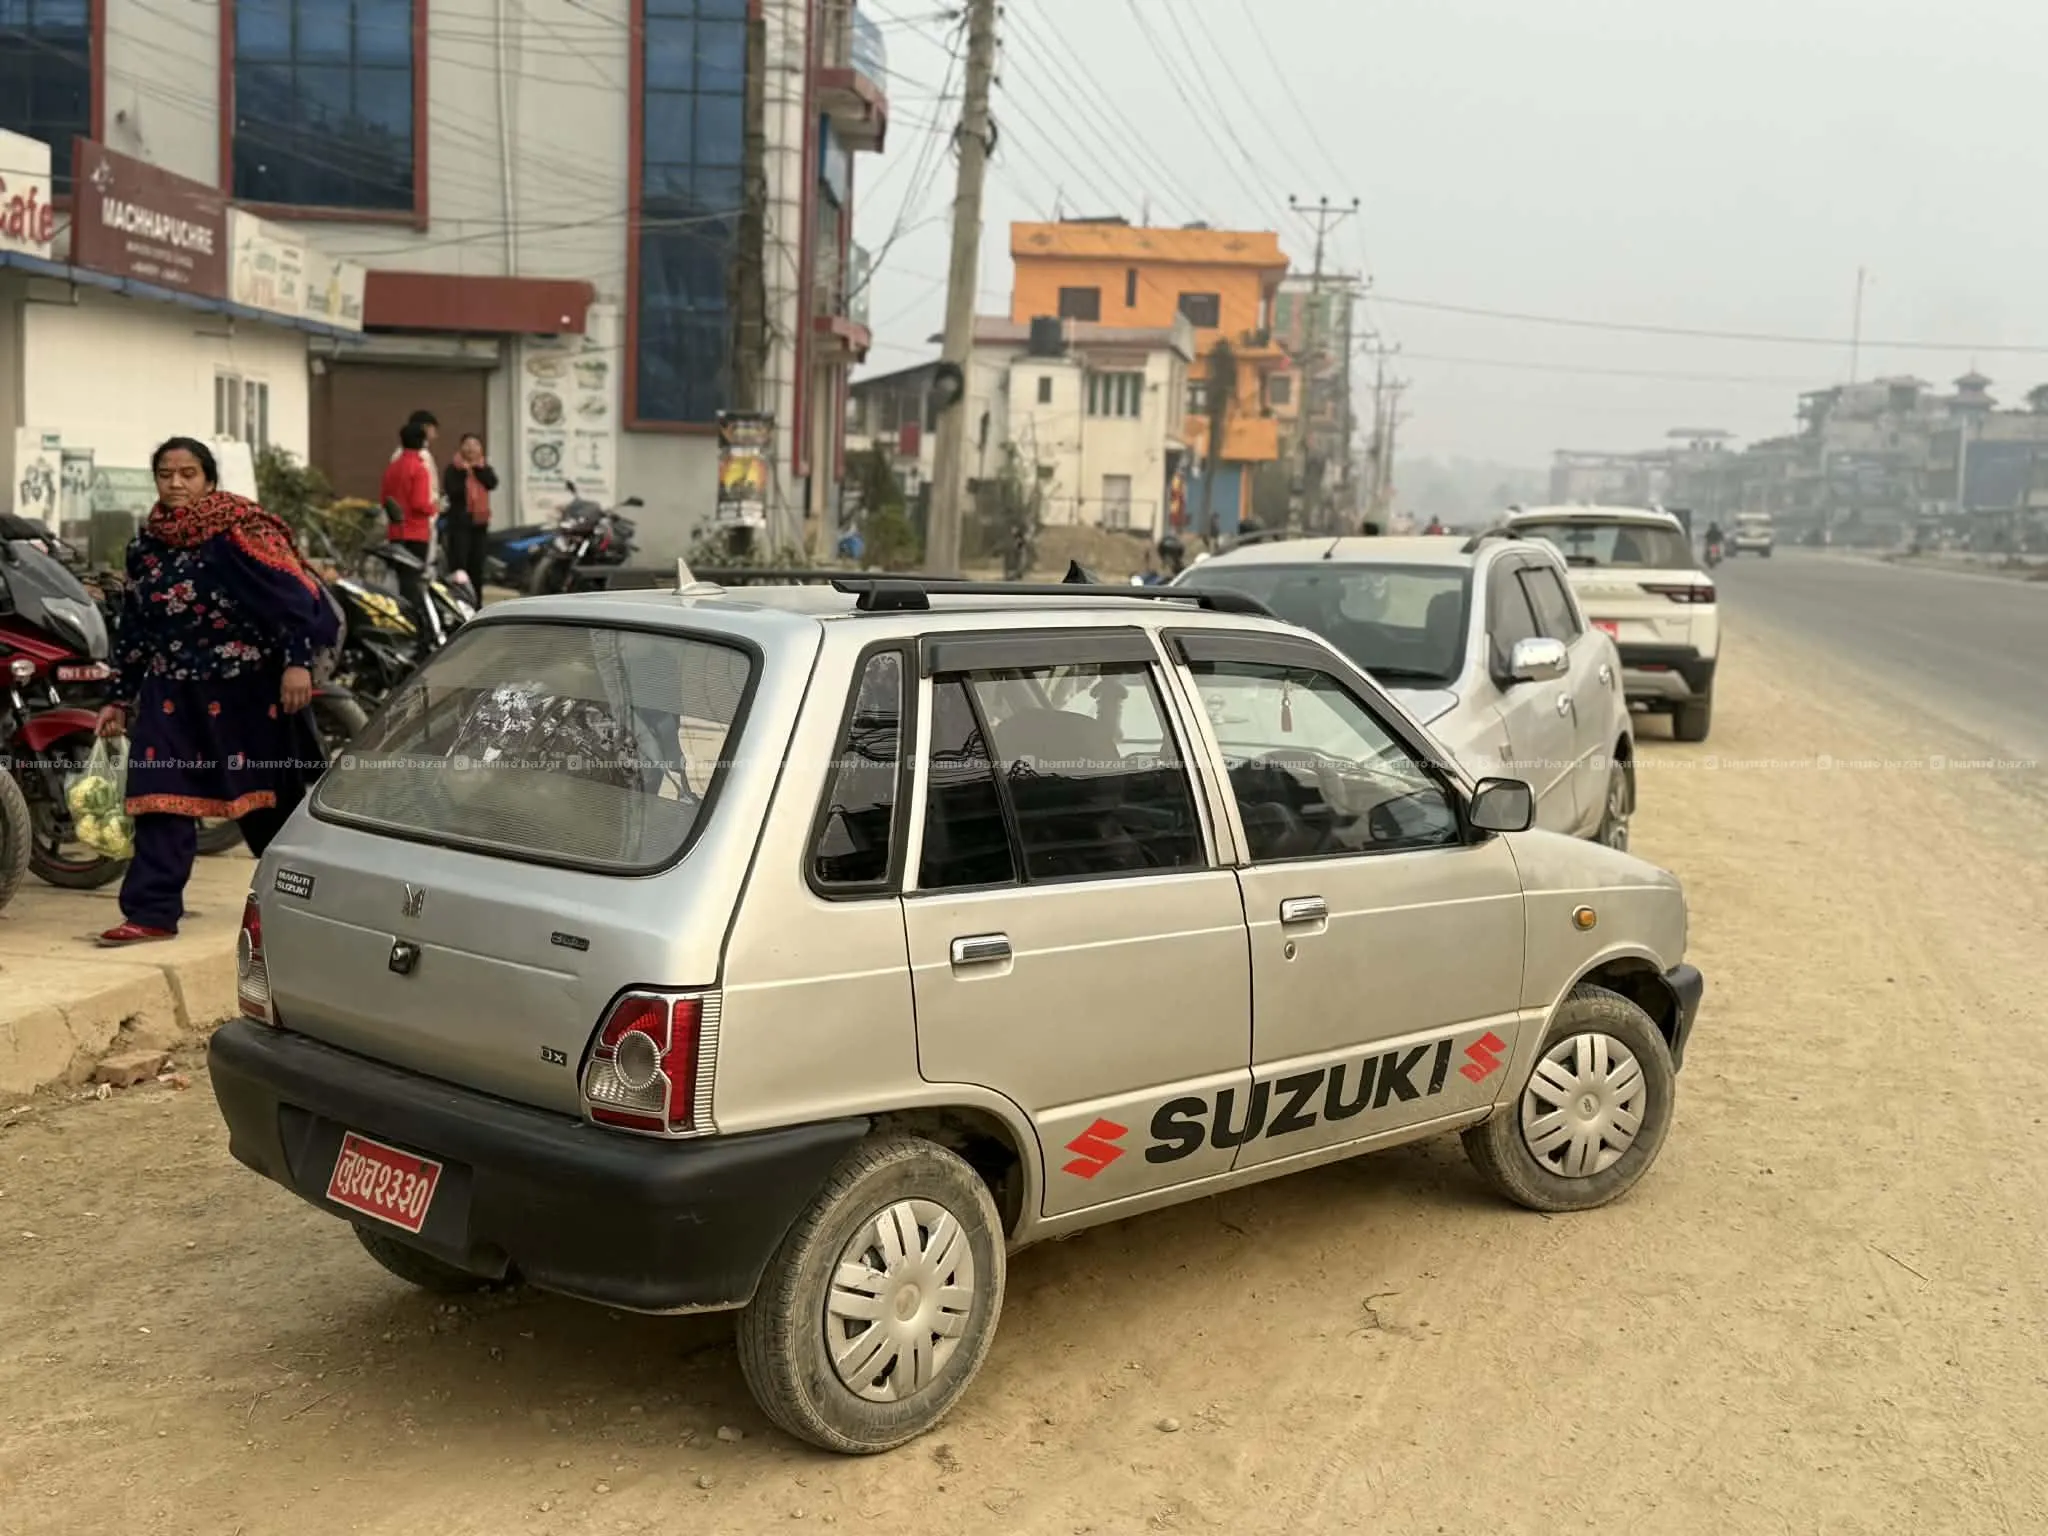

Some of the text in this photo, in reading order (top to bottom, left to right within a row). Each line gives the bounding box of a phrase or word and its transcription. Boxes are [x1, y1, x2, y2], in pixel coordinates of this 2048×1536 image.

[0, 177, 56, 241] afe
[277, 880, 308, 896] SUZUKI
[278, 871, 310, 886] MARUTI
[1144, 1039, 1454, 1164] SUZUKI
